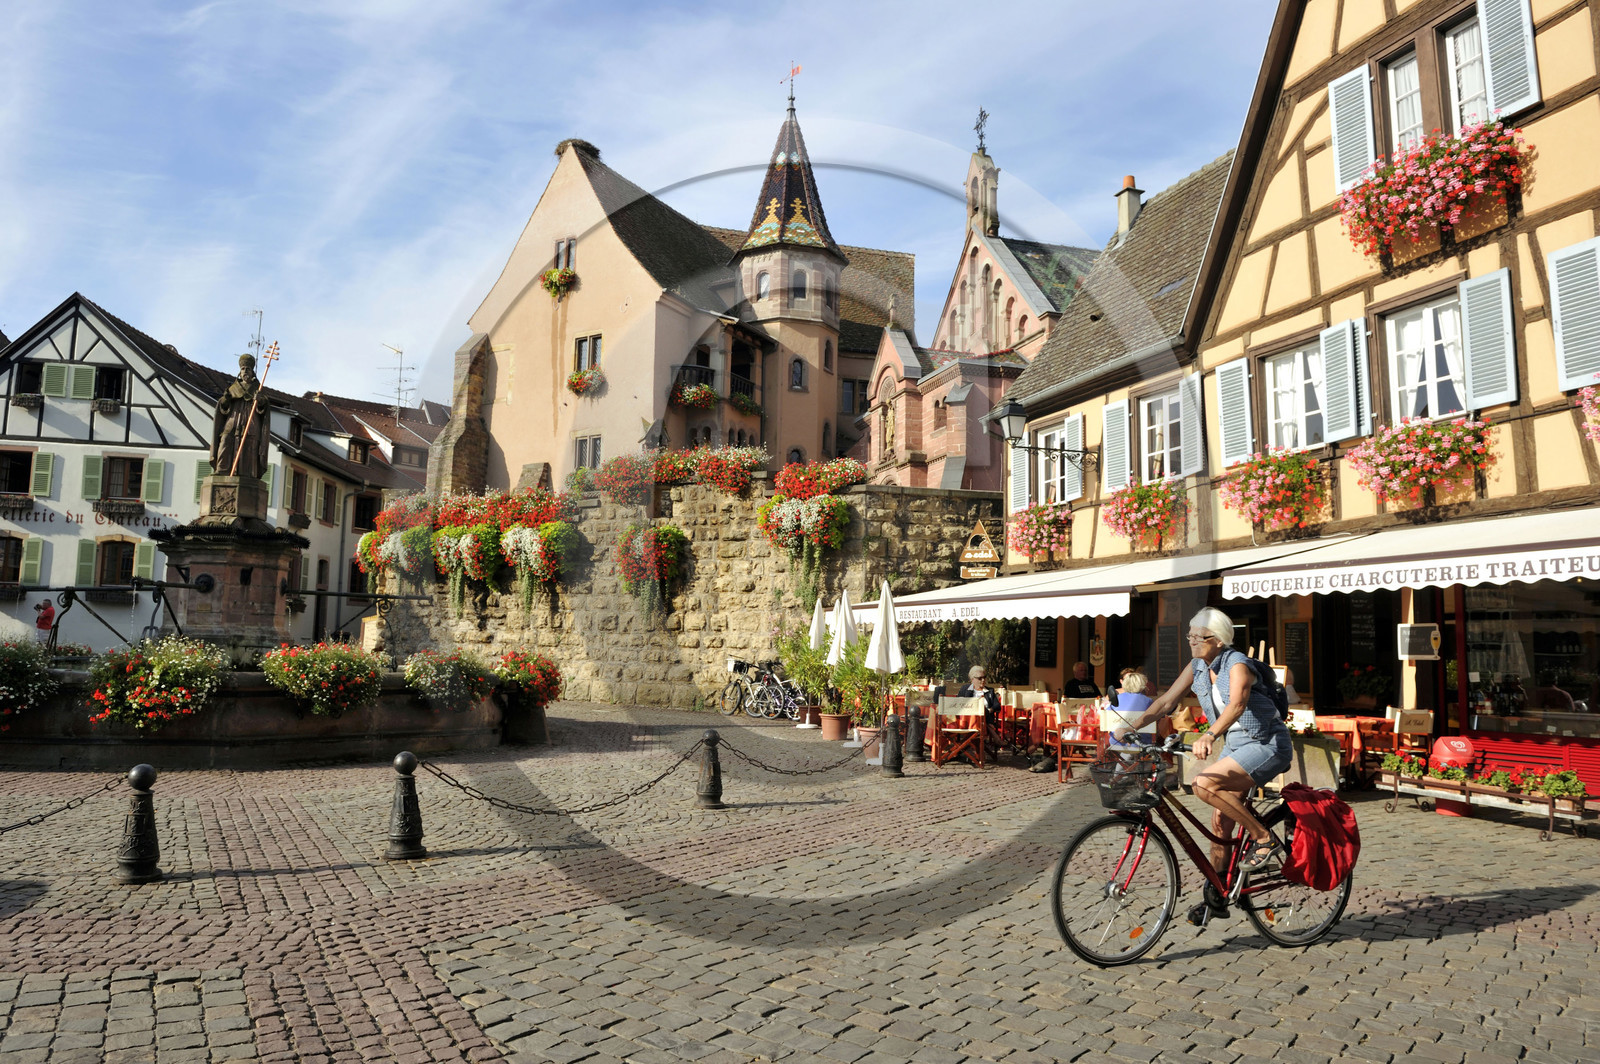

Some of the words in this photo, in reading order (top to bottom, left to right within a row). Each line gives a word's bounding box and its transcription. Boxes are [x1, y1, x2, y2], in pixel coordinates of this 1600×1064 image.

[3, 509, 55, 522] ellerie
[66, 509, 84, 523] du
[1231, 575, 1325, 595] BOUCHERIE
[1328, 564, 1480, 588] CHARCUTERIE
[1486, 554, 1600, 579] TRAITEU
[900, 609, 942, 619] RESTAURANT
[961, 607, 980, 617] EDEL
